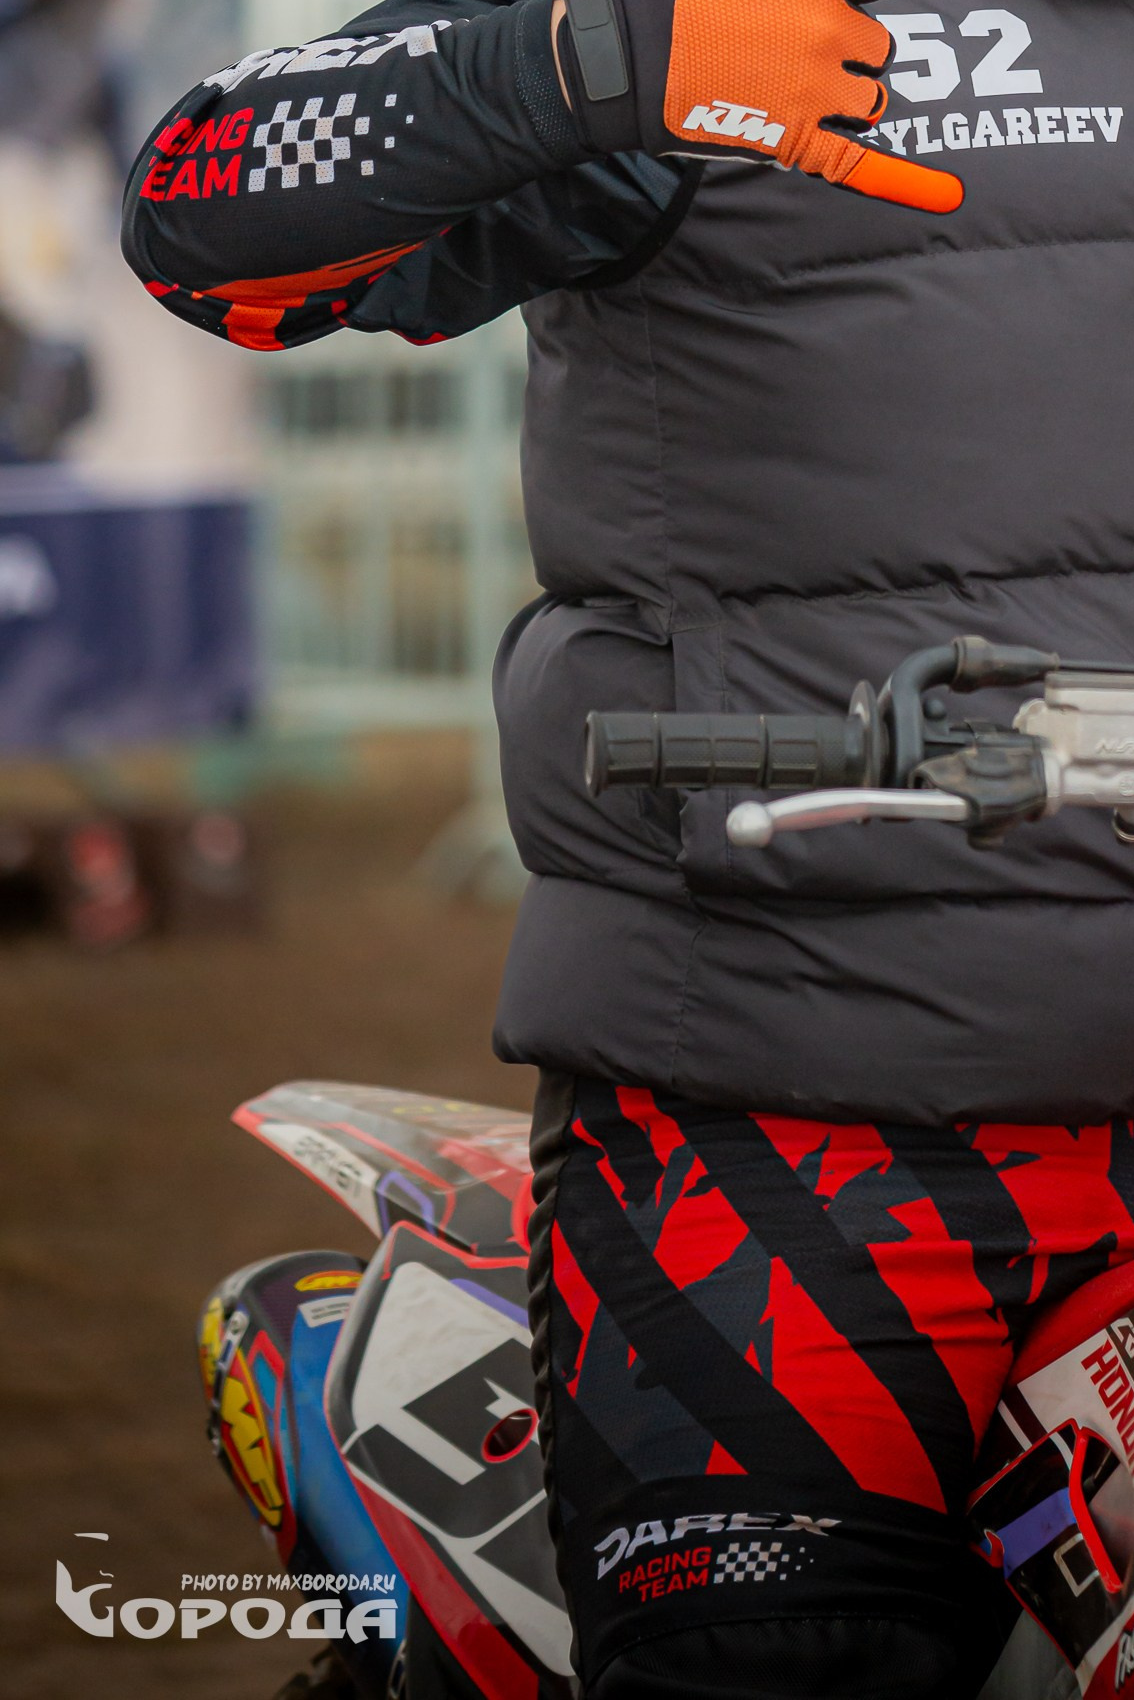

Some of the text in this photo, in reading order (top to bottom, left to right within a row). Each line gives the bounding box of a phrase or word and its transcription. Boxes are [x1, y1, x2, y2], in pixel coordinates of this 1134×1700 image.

[876, 9, 1043, 103] 52
[682, 100, 786, 148] KTM
[139, 154, 242, 201] EAM
[594, 1512, 842, 1581] DAREX
[618, 1546, 712, 1593] RACING
[637, 1567, 709, 1602] TEAM
